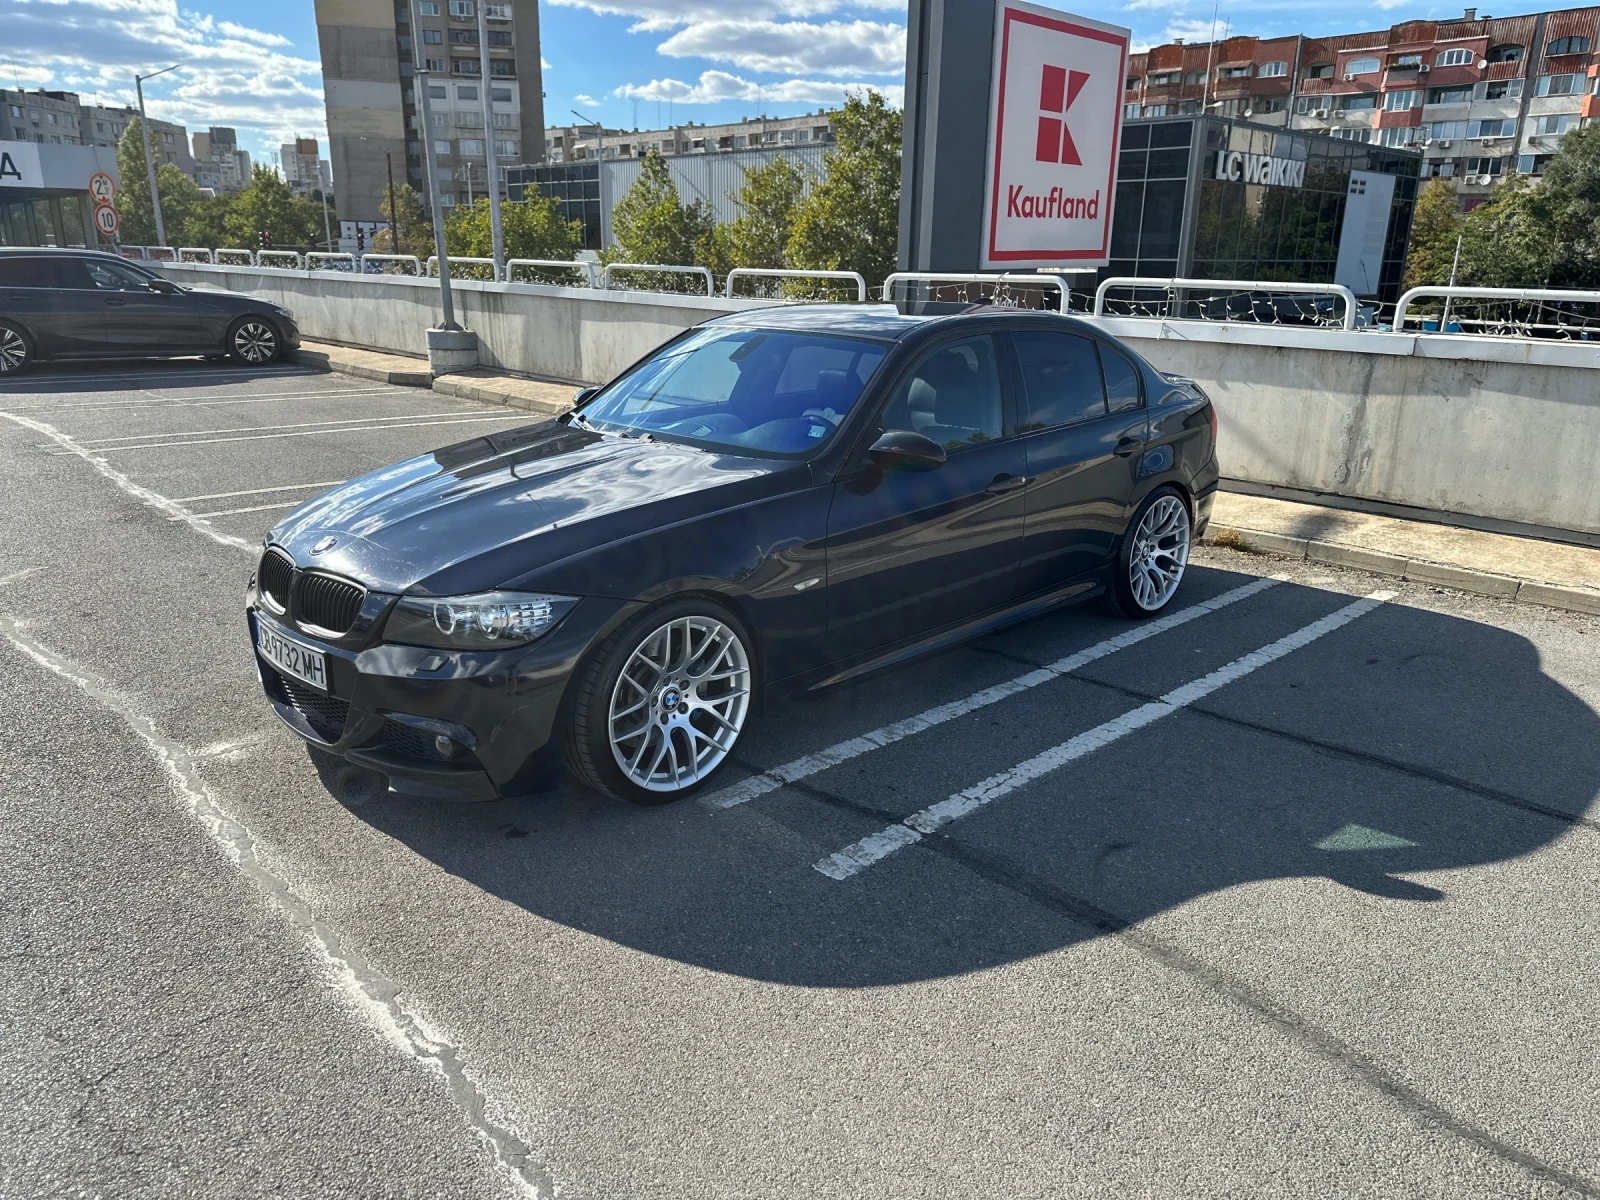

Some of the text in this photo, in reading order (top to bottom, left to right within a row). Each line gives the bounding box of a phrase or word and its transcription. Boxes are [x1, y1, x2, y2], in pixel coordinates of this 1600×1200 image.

[1216, 150, 1242, 182] LC
[1007, 185, 1100, 219] Kaufland
[101, 212, 114, 228] 10
